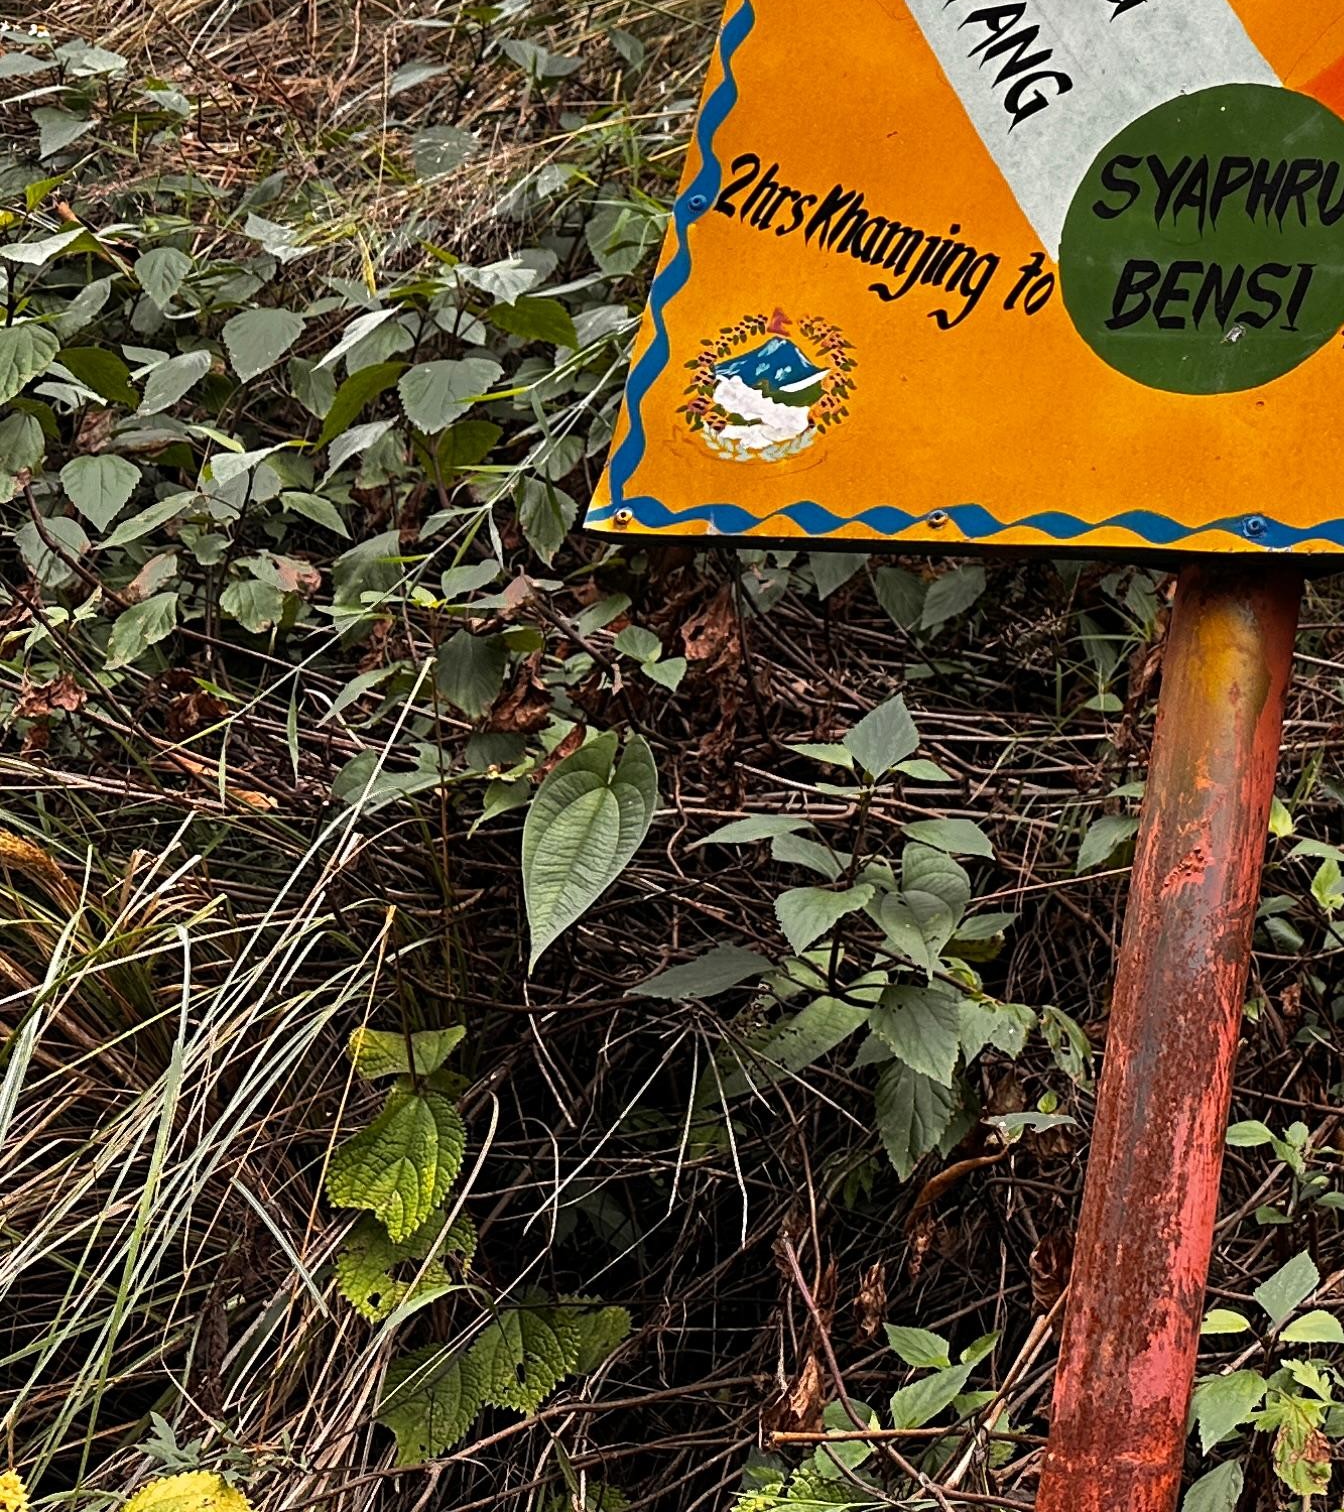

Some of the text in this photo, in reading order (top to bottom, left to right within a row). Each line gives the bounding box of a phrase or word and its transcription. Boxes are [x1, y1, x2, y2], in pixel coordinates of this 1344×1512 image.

[803, 183, 1001, 331] Khamjing
[1002, 251, 1056, 317] to
[1103, 258, 1318, 333] BENSI
